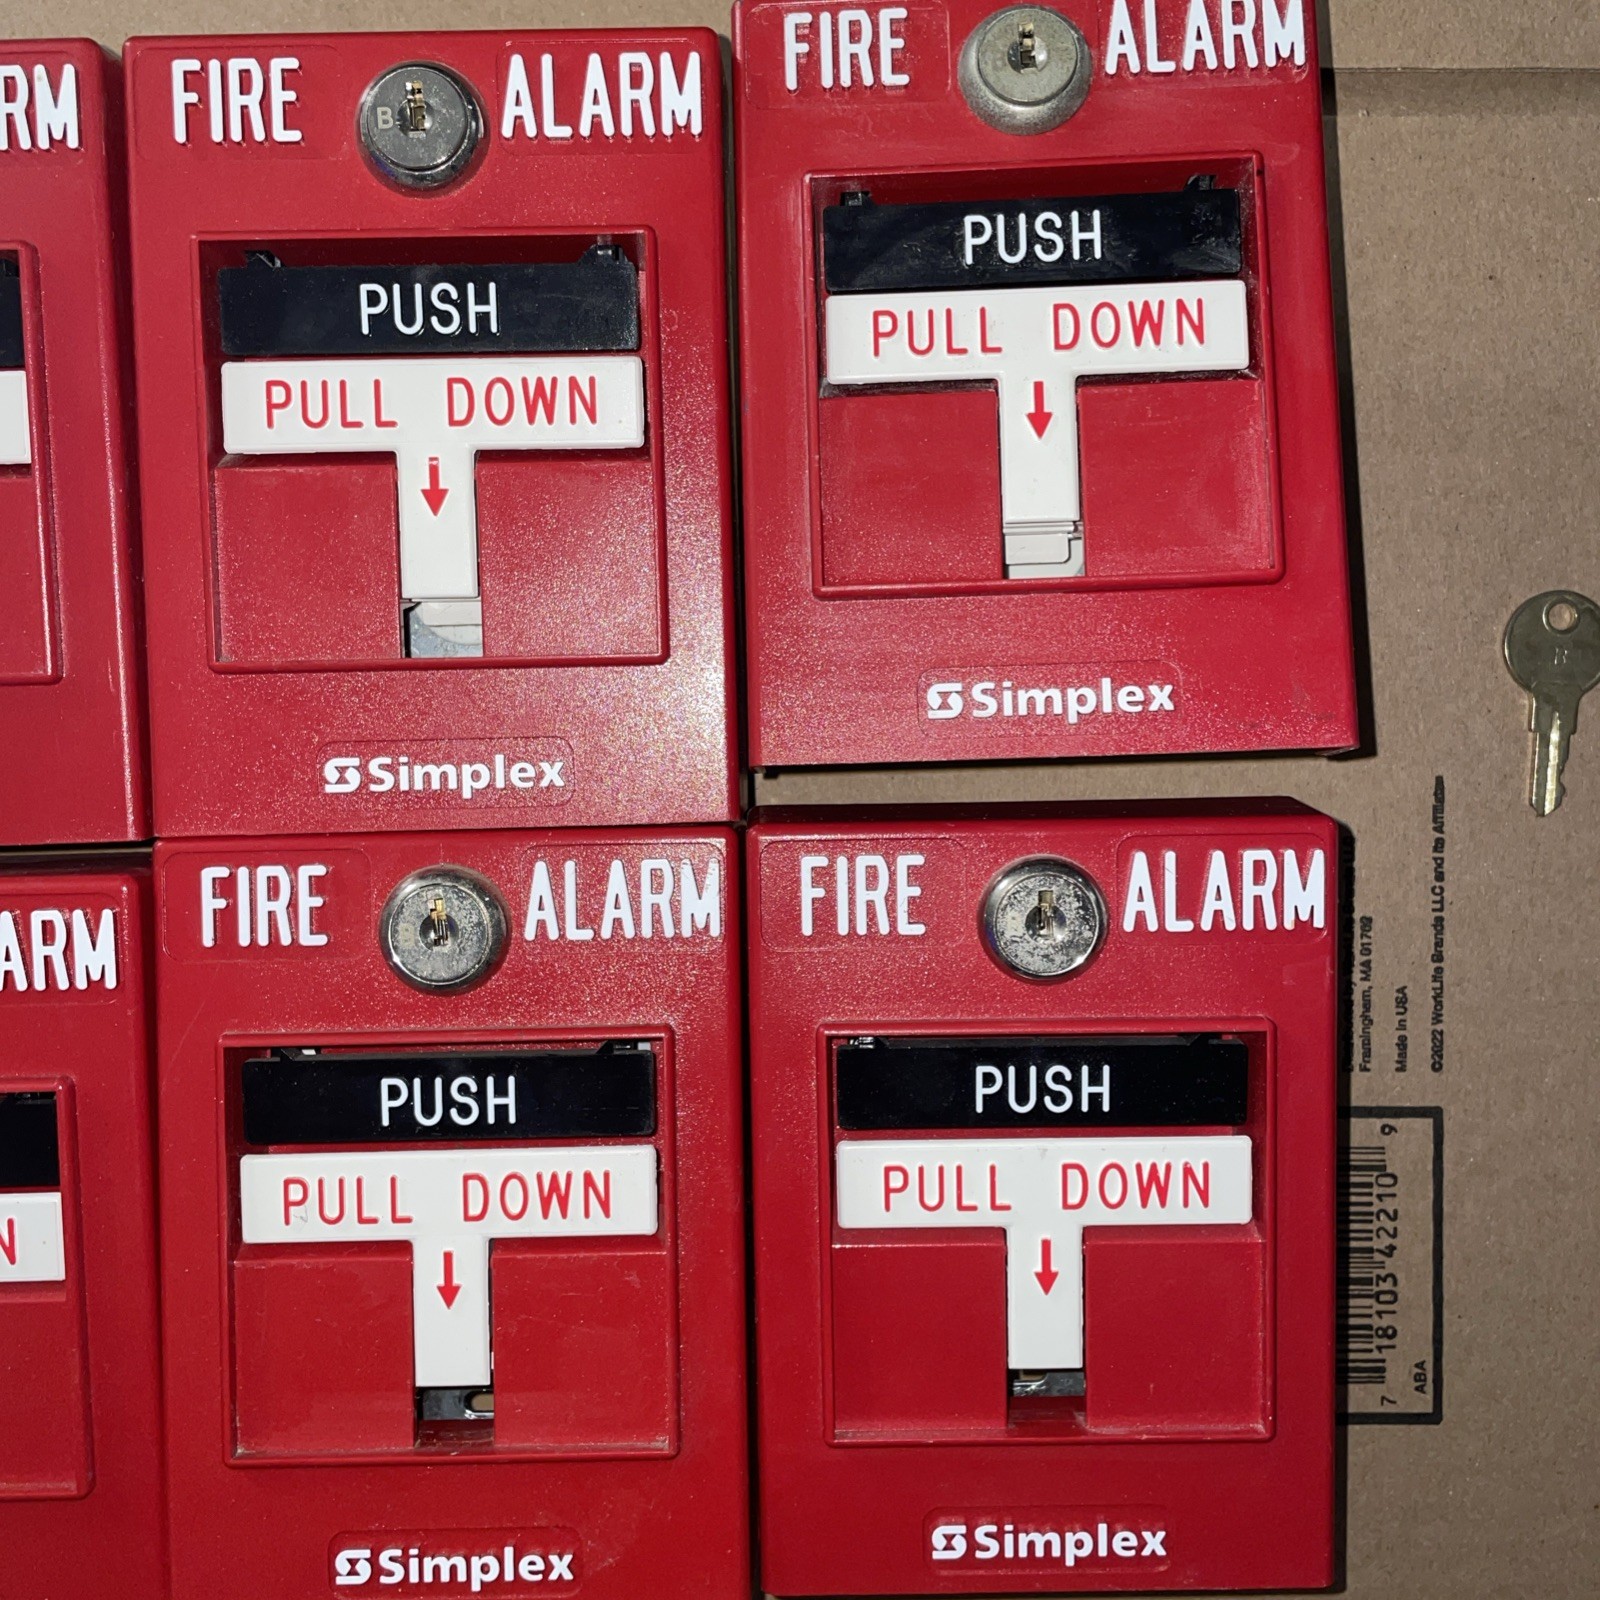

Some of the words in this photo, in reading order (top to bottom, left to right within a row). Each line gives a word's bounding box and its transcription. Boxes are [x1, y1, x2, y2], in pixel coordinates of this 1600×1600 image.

[784, 8, 909, 90] FIRE
[1105, 0, 1305, 74] ALARM
[172, 58, 302, 143] FIRE
[502, 52, 702, 138] ALARM
[376, 106, 394, 130] B
[964, 210, 1101, 264] PUSH
[360, 282, 497, 334] PUSH
[873, 308, 1001, 356] PULL
[1053, 298, 1204, 350] DOWN
[266, 380, 396, 428] PULL
[447, 376, 597, 426] DOWN
[968, 678, 1176, 724] Simplex
[368, 754, 566, 799] Simplex
[797, 851, 926, 936] FIRE
[1123, 849, 1324, 932] ALARM
[1432, 857, 1445, 883] and
[201, 863, 327, 947] FIRE
[524, 860, 722, 941] ALARM
[1431, 885, 1445, 913] LLC
[0, 909, 116, 991] ARM
[1431, 915, 1445, 964] Brands
[1360, 959, 1372, 982] MA
[1395, 986, 1408, 1016] USA
[1395, 1016, 1408, 1032] in
[1359, 985, 1373, 1073] Framingham,
[1431, 1028, 1444, 1073] ©2022
[1395, 1035, 1408, 1073] Made
[381, 1076, 515, 1126] PUSH
[976, 1065, 1109, 1113] PUSH
[1380, 1123, 1398, 1136] 9
[284, 1177, 412, 1225] PULL
[463, 1171, 610, 1222] DOWN
[884, 1165, 1011, 1211] PULL
[1062, 1162, 1209, 1210] DOWN
[1375, 1172, 1398, 1259] 42210
[1375, 1272, 1398, 1354] 18103
[1380, 1395, 1398, 1407] 7
[1414, 1360, 1426, 1395] ABA
[379, 1547, 573, 1591] Simplex
[975, 1524, 1166, 1566] Simplex
